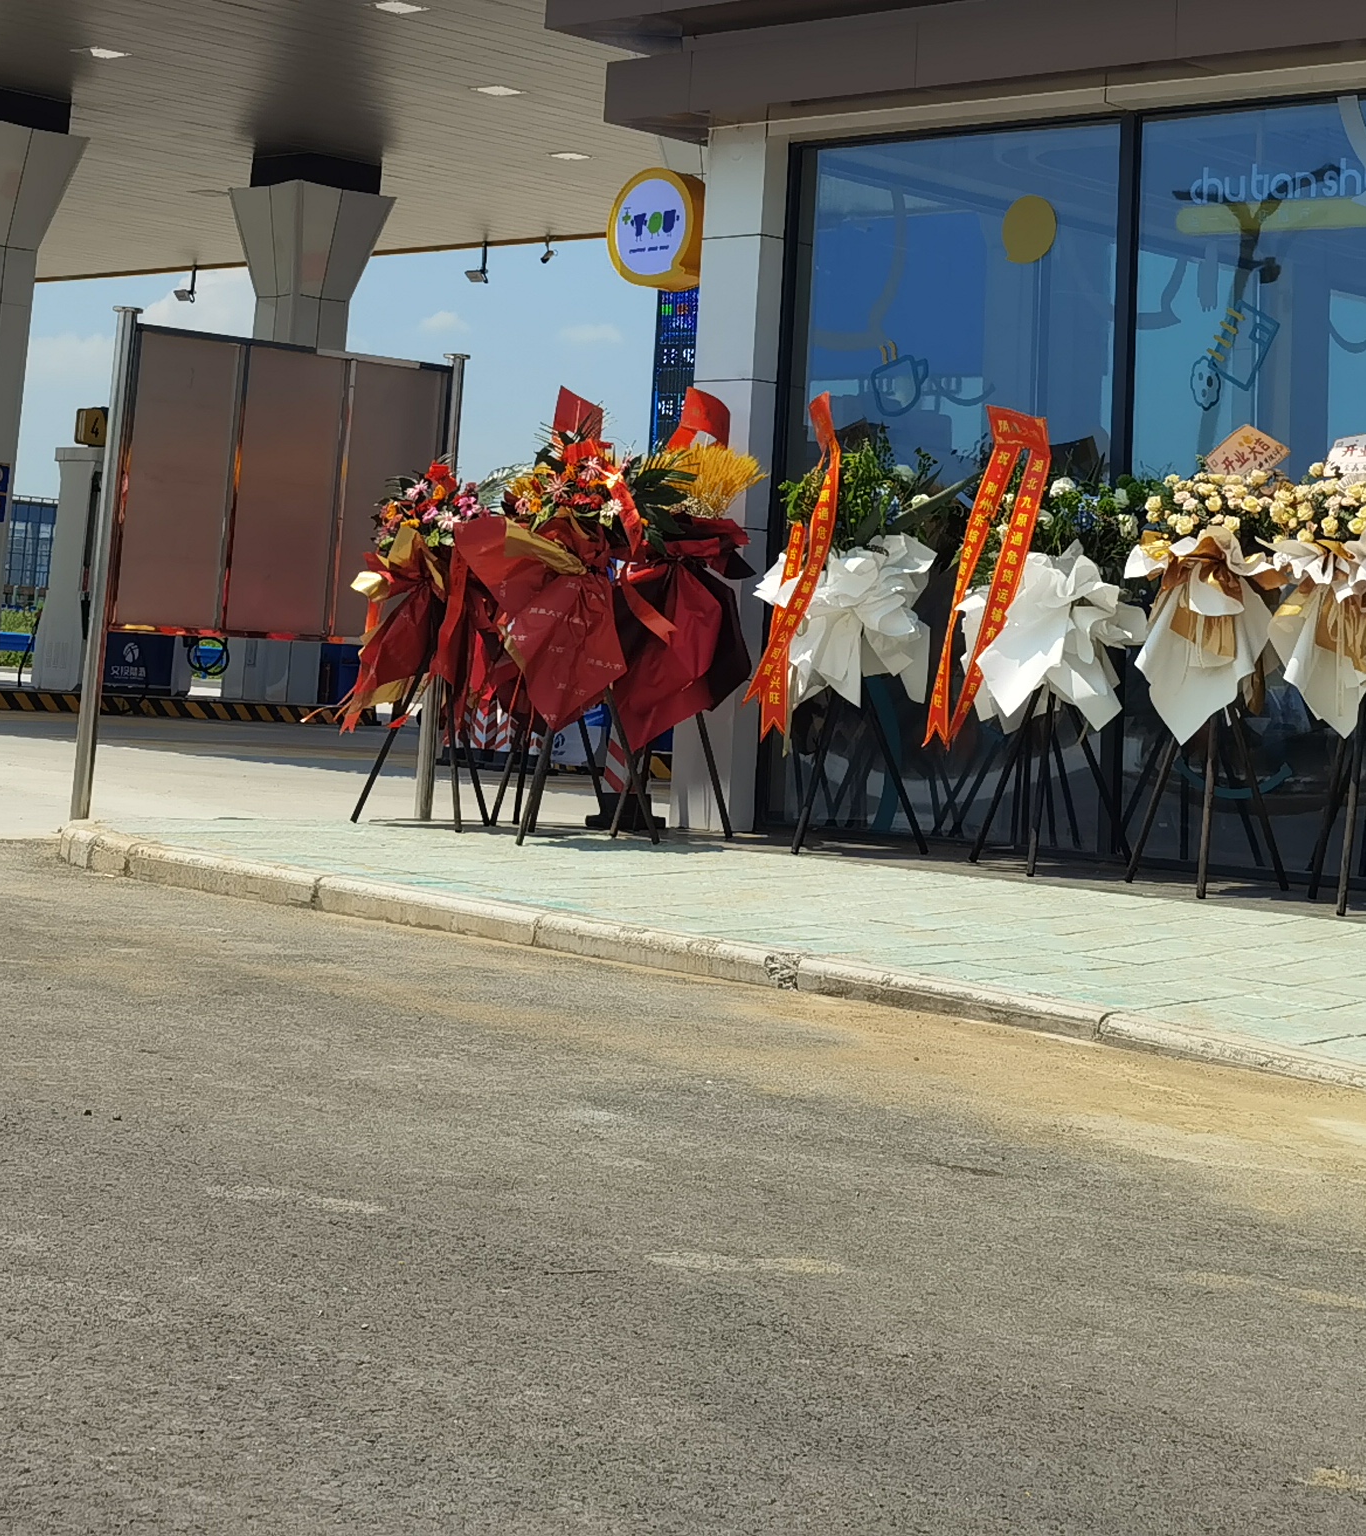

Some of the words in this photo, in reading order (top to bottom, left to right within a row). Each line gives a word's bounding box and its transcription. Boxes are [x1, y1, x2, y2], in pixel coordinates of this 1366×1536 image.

[90, 416, 100, 438] 4
[1221, 437, 1271, 476] 开业大吉
